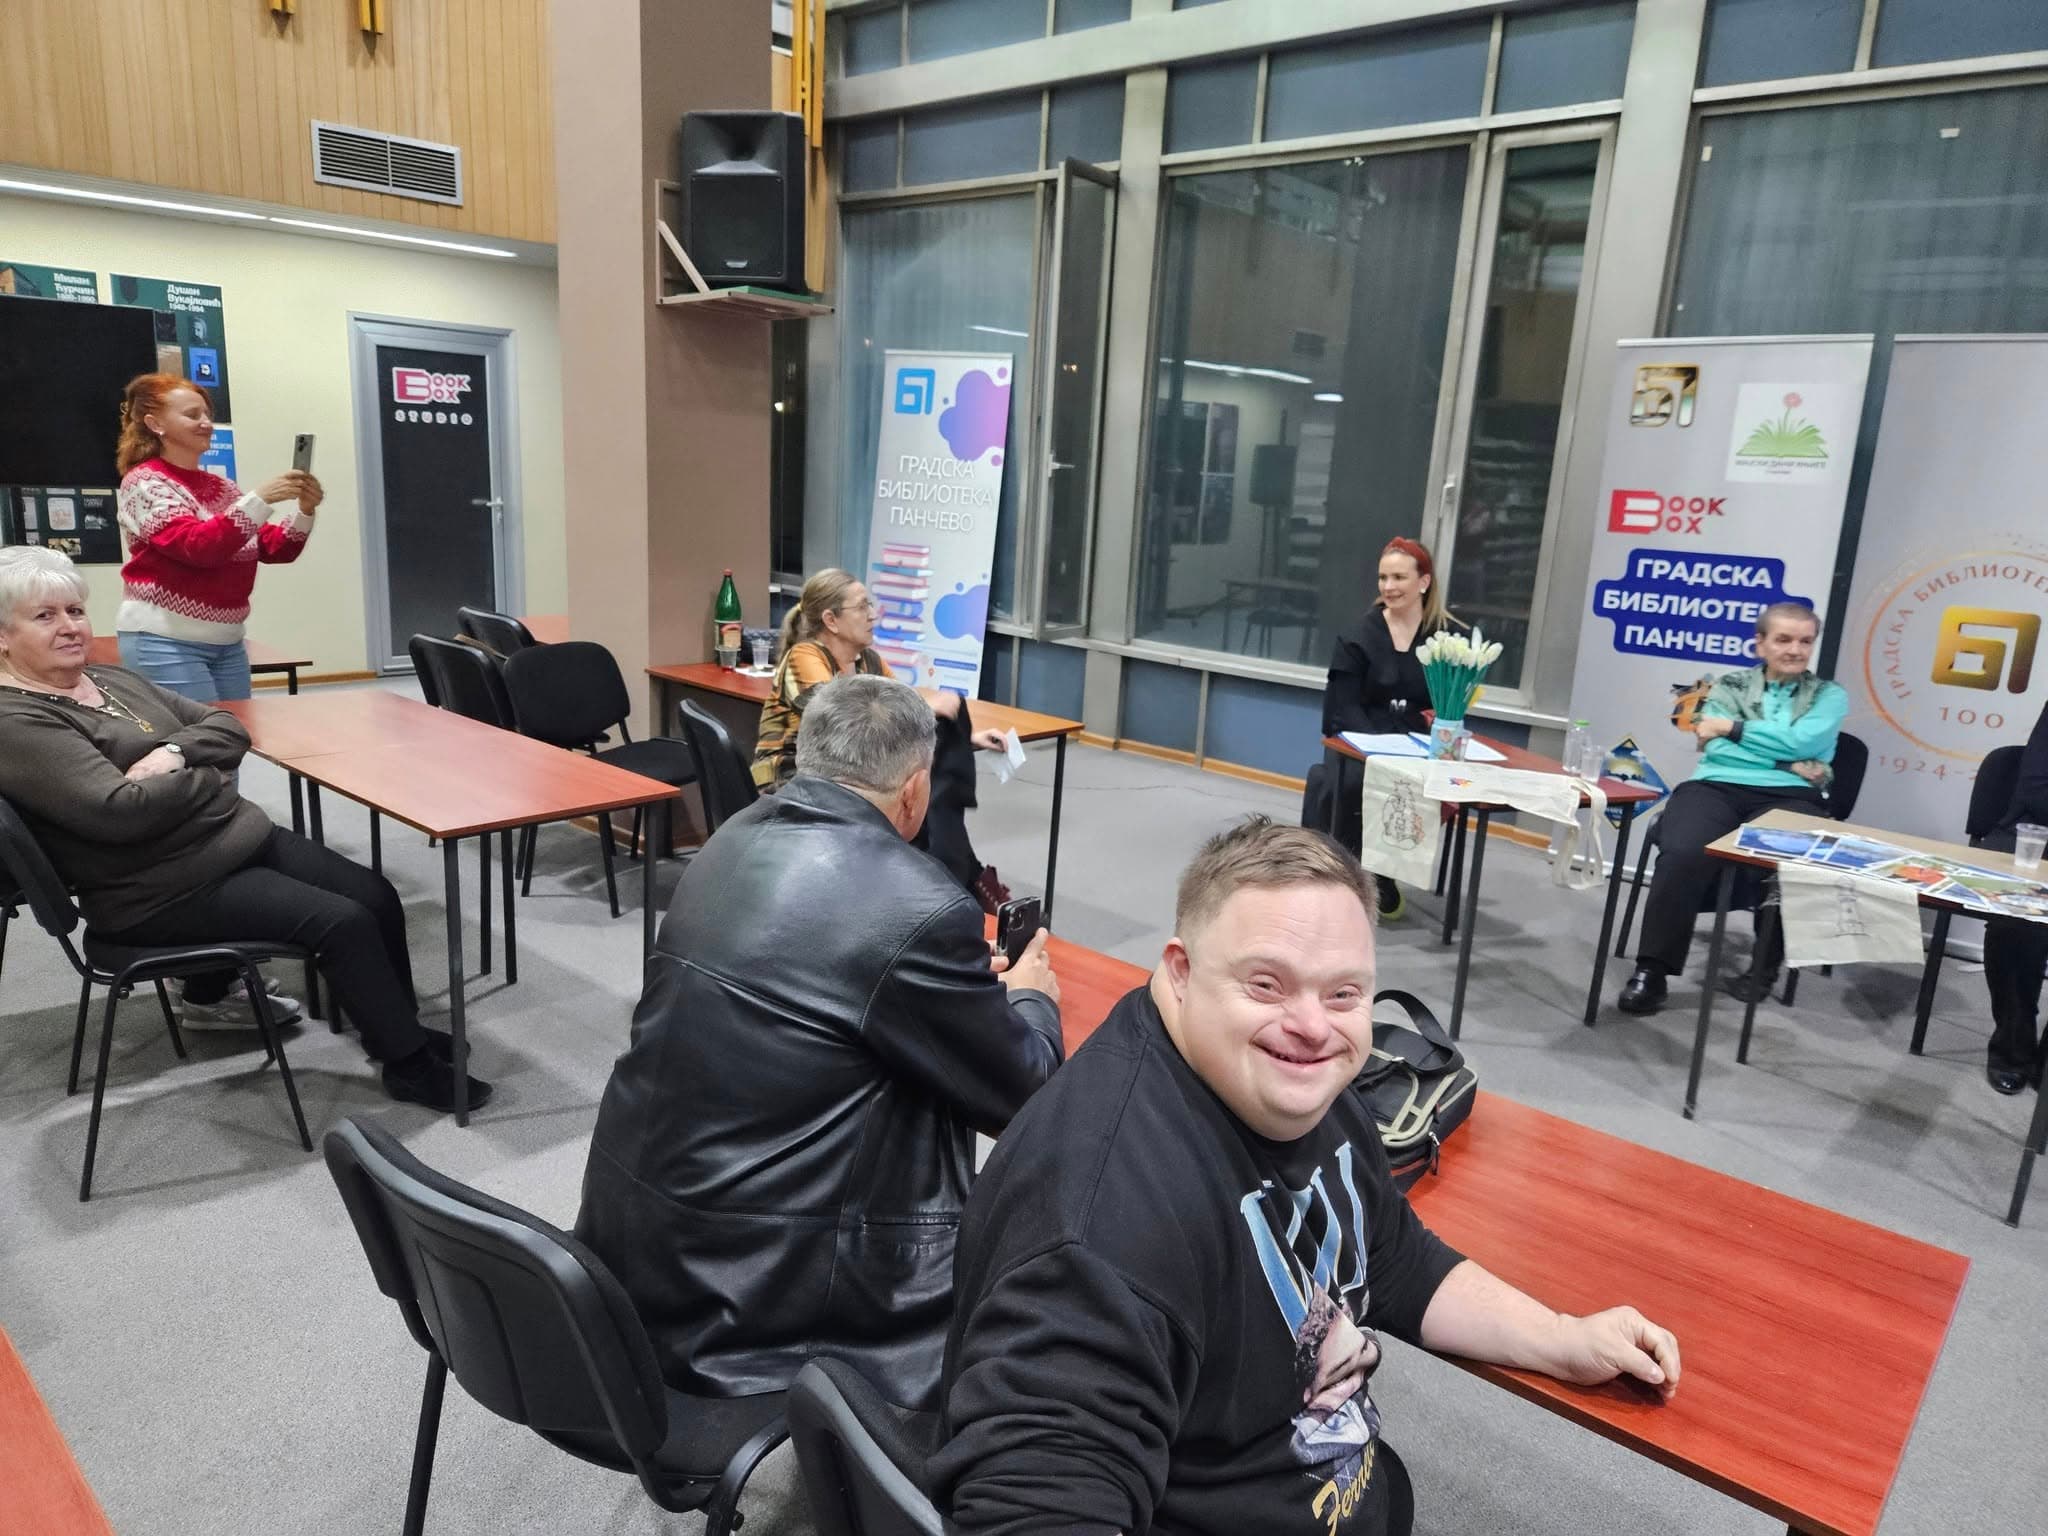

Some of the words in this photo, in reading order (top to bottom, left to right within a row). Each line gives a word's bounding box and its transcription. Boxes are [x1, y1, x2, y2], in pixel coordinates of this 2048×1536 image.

[167, 284, 201, 296] Душан
[168, 294, 222, 308] Вукајловић
[394, 409, 473, 425] STUDIO
[899, 455, 976, 479] ГРАДСКА
[878, 479, 993, 507] БИБЛИОТЕКА
[889, 505, 974, 532] ПАНЧЕВО
[1636, 558, 1773, 590] ГРАДСКА
[1602, 589, 1767, 624] БИБЛИОТЕ
[1883, 607, 1914, 700] ГРАДСКА
[1914, 563, 2048, 603] БИБЛИОТЕ
[1938, 706, 2005, 729] 100
